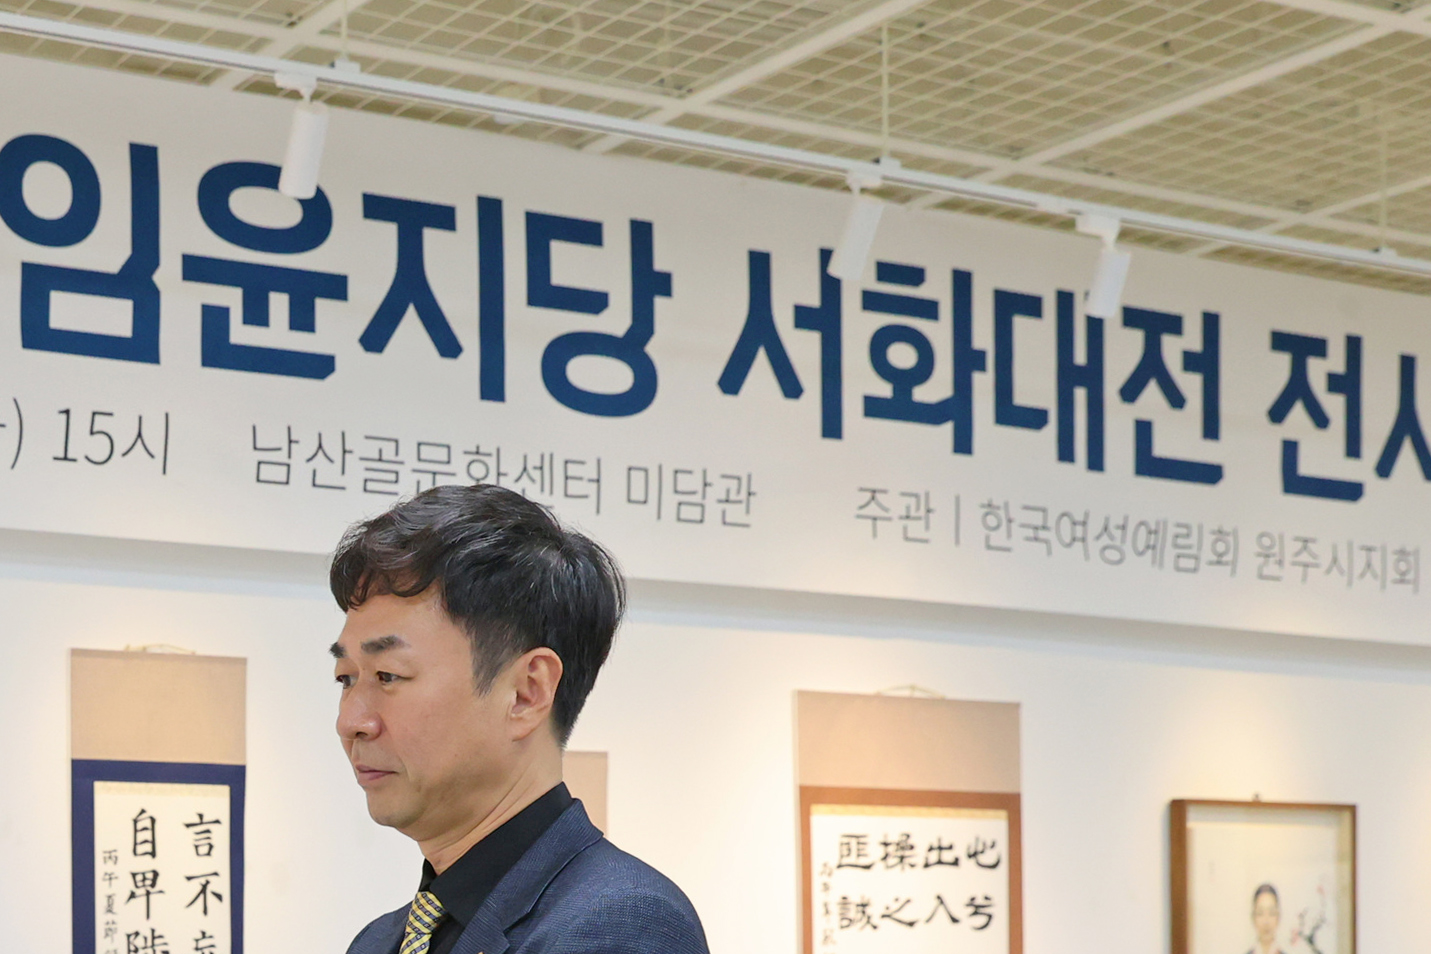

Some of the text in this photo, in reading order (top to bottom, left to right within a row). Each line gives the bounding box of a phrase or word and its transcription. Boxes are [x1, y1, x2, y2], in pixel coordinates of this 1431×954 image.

[717, 247, 1224, 485] 서화대전
[52, 407, 170, 476] 15시
[251, 423, 602, 516] 남산골문화센터
[626, 463, 757, 528] 미담관
[854, 486, 936, 545] 주관
[978, 497, 1240, 578] 한국여성예림회
[1253, 530, 1421, 595] 원주시지회
